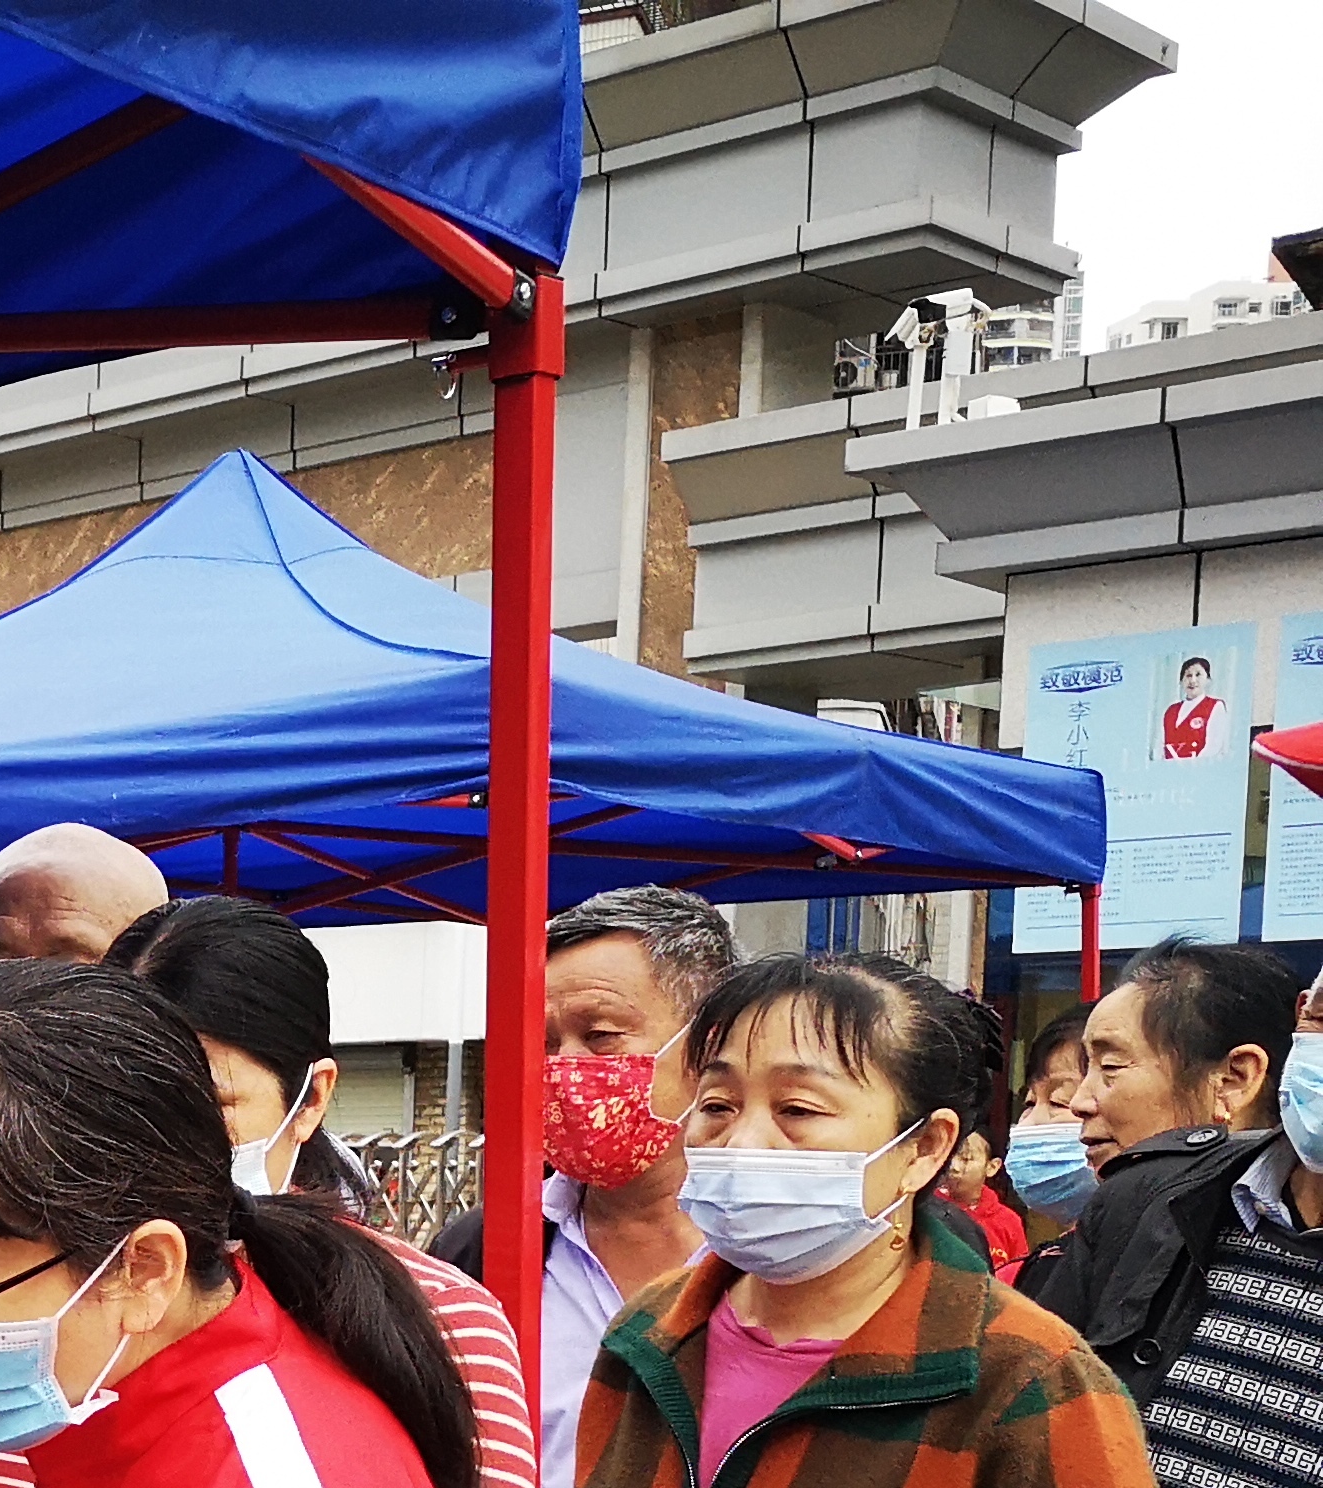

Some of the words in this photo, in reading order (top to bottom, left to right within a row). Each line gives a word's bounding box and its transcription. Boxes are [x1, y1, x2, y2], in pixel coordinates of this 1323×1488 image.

[1039, 664, 1124, 690] 致敬模范
[1066, 700, 1091, 767] 李小红
